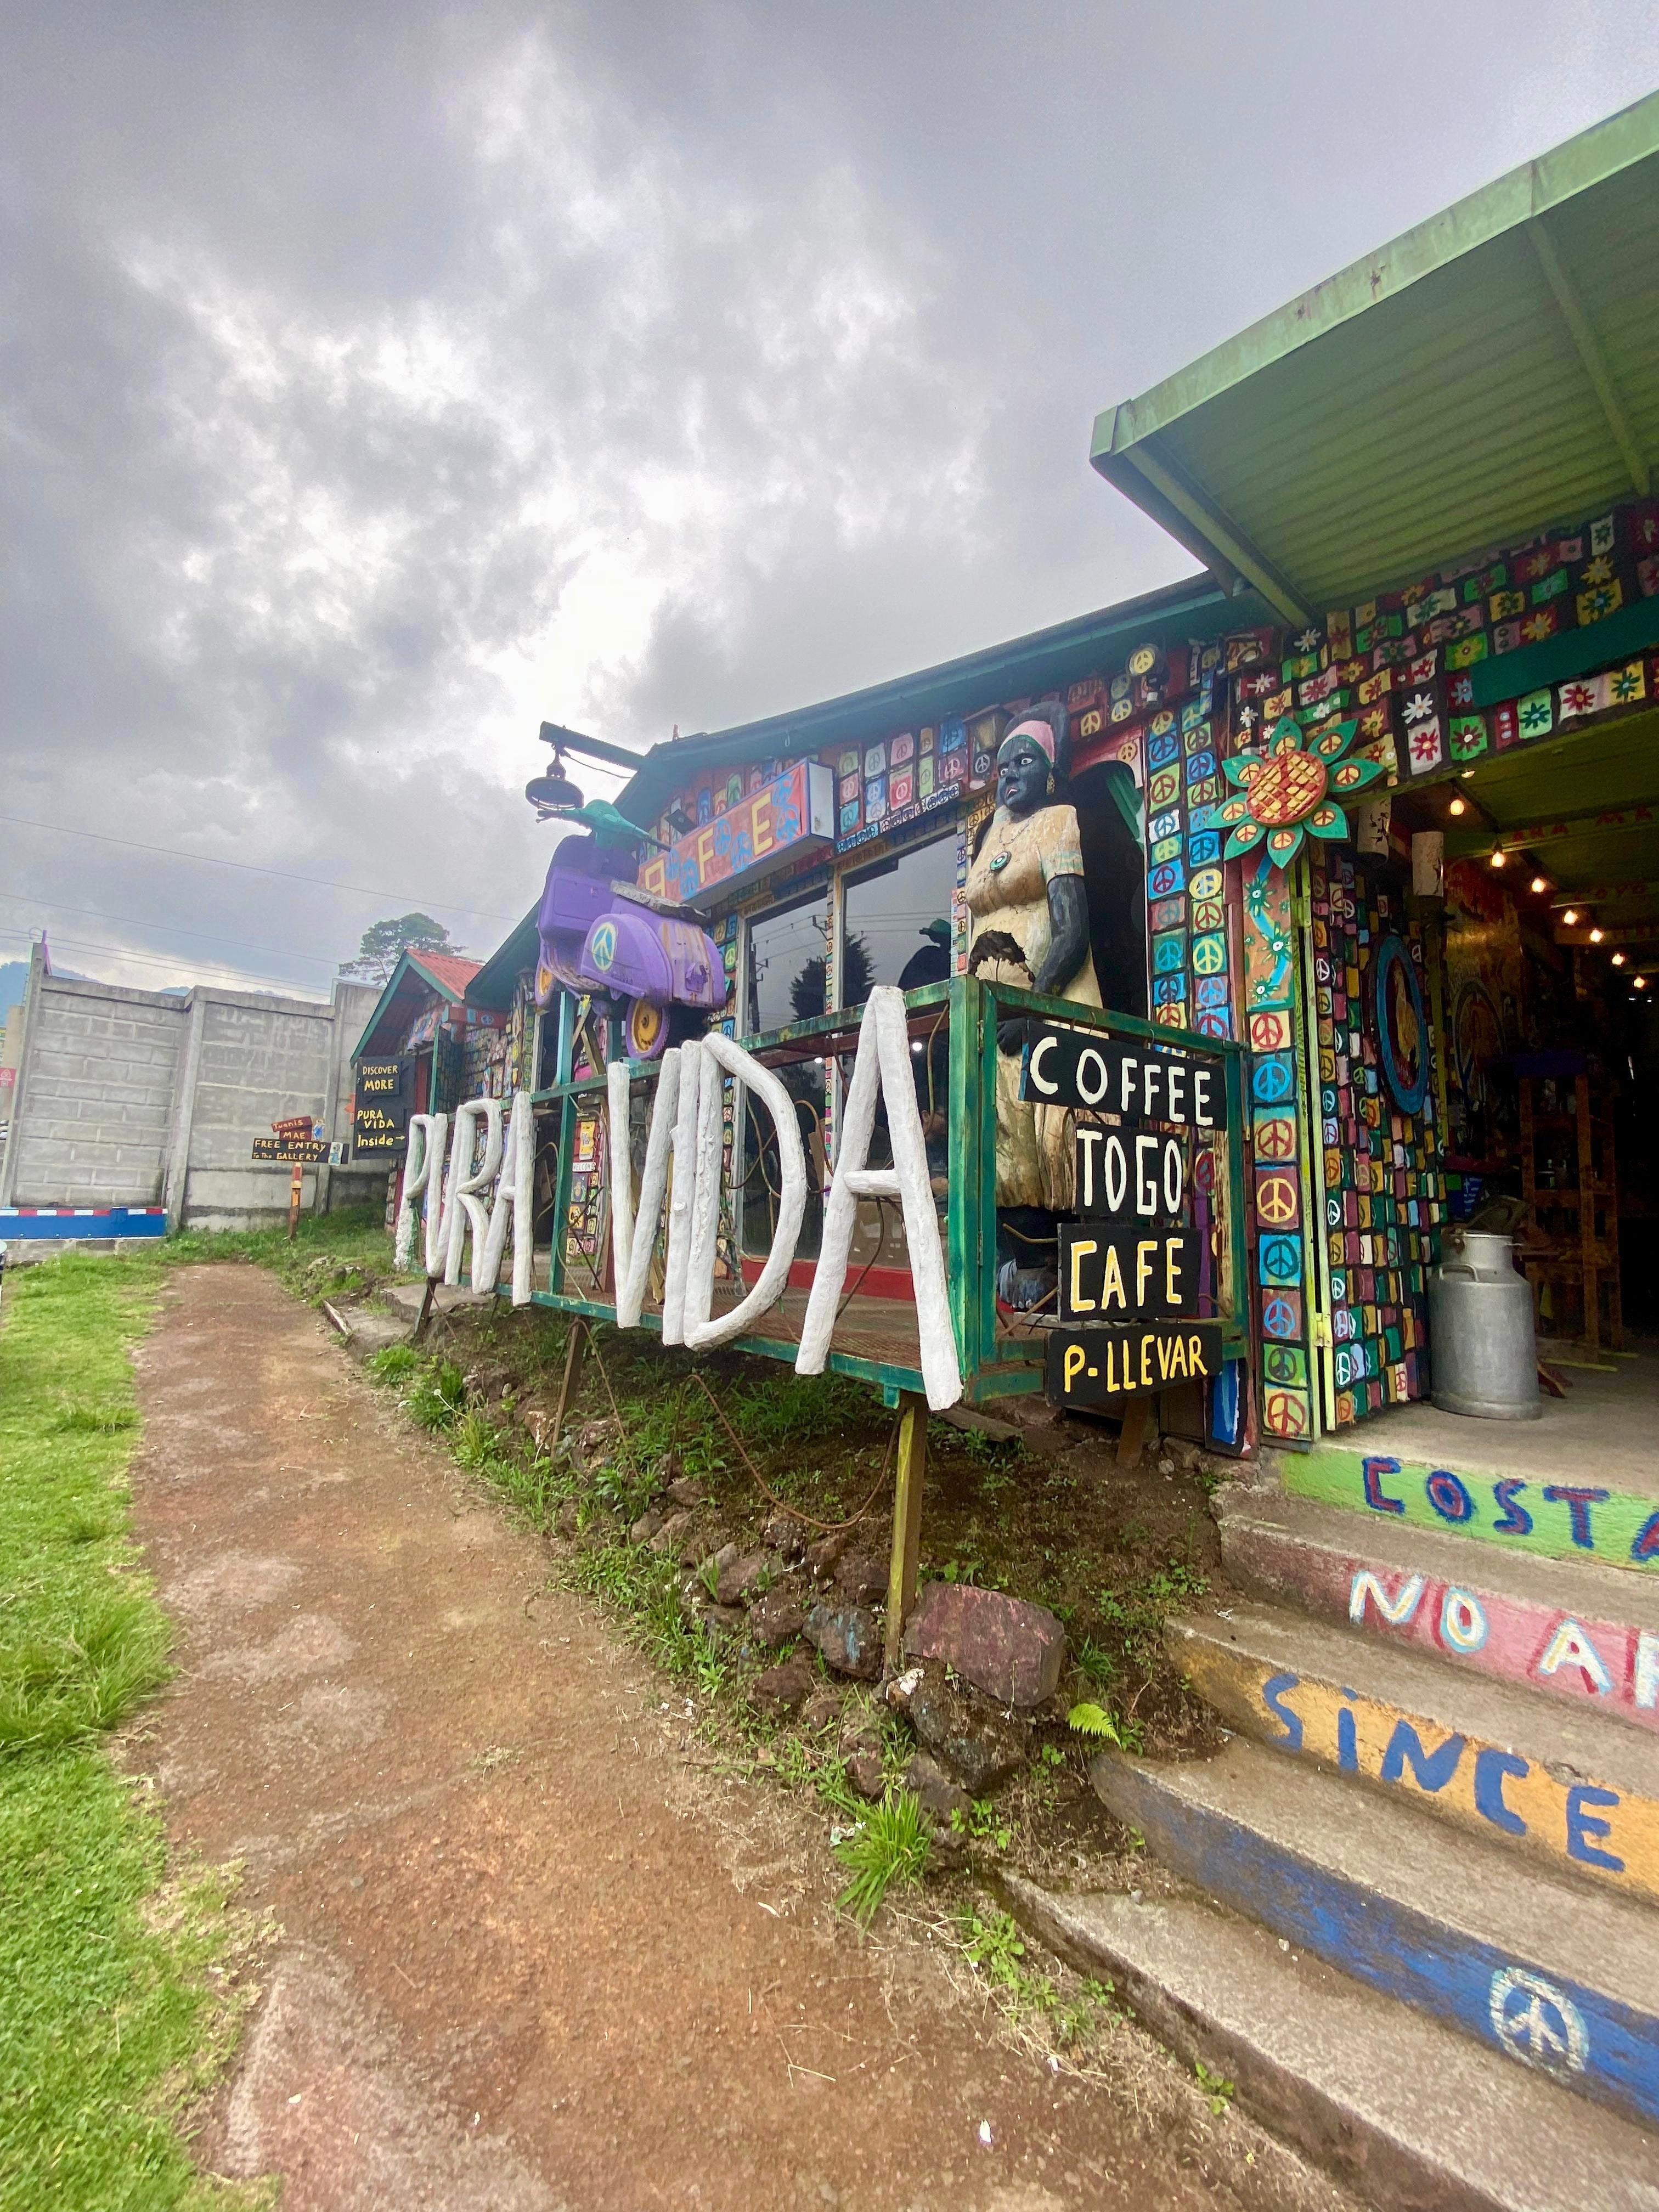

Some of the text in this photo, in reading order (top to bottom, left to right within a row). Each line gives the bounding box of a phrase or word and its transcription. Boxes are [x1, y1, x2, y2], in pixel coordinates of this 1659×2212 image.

[644, 792, 773, 899] AFE
[363, 1065, 398, 1075] DISCOVER
[364, 1079, 394, 1091] MORE
[1029, 1036, 1214, 1126] COFFEE
[357, 1109, 383, 1120] PURA
[283, 1131, 306, 1139] MAE
[357, 1133, 394, 1147] Inside
[255, 1140, 326, 1152] FREE ENTRY
[1070, 1238, 1183, 1312] CAFE
[1064, 1334, 1208, 1393] P-LLEVAR
[1348, 1570, 1489, 1654] NO
